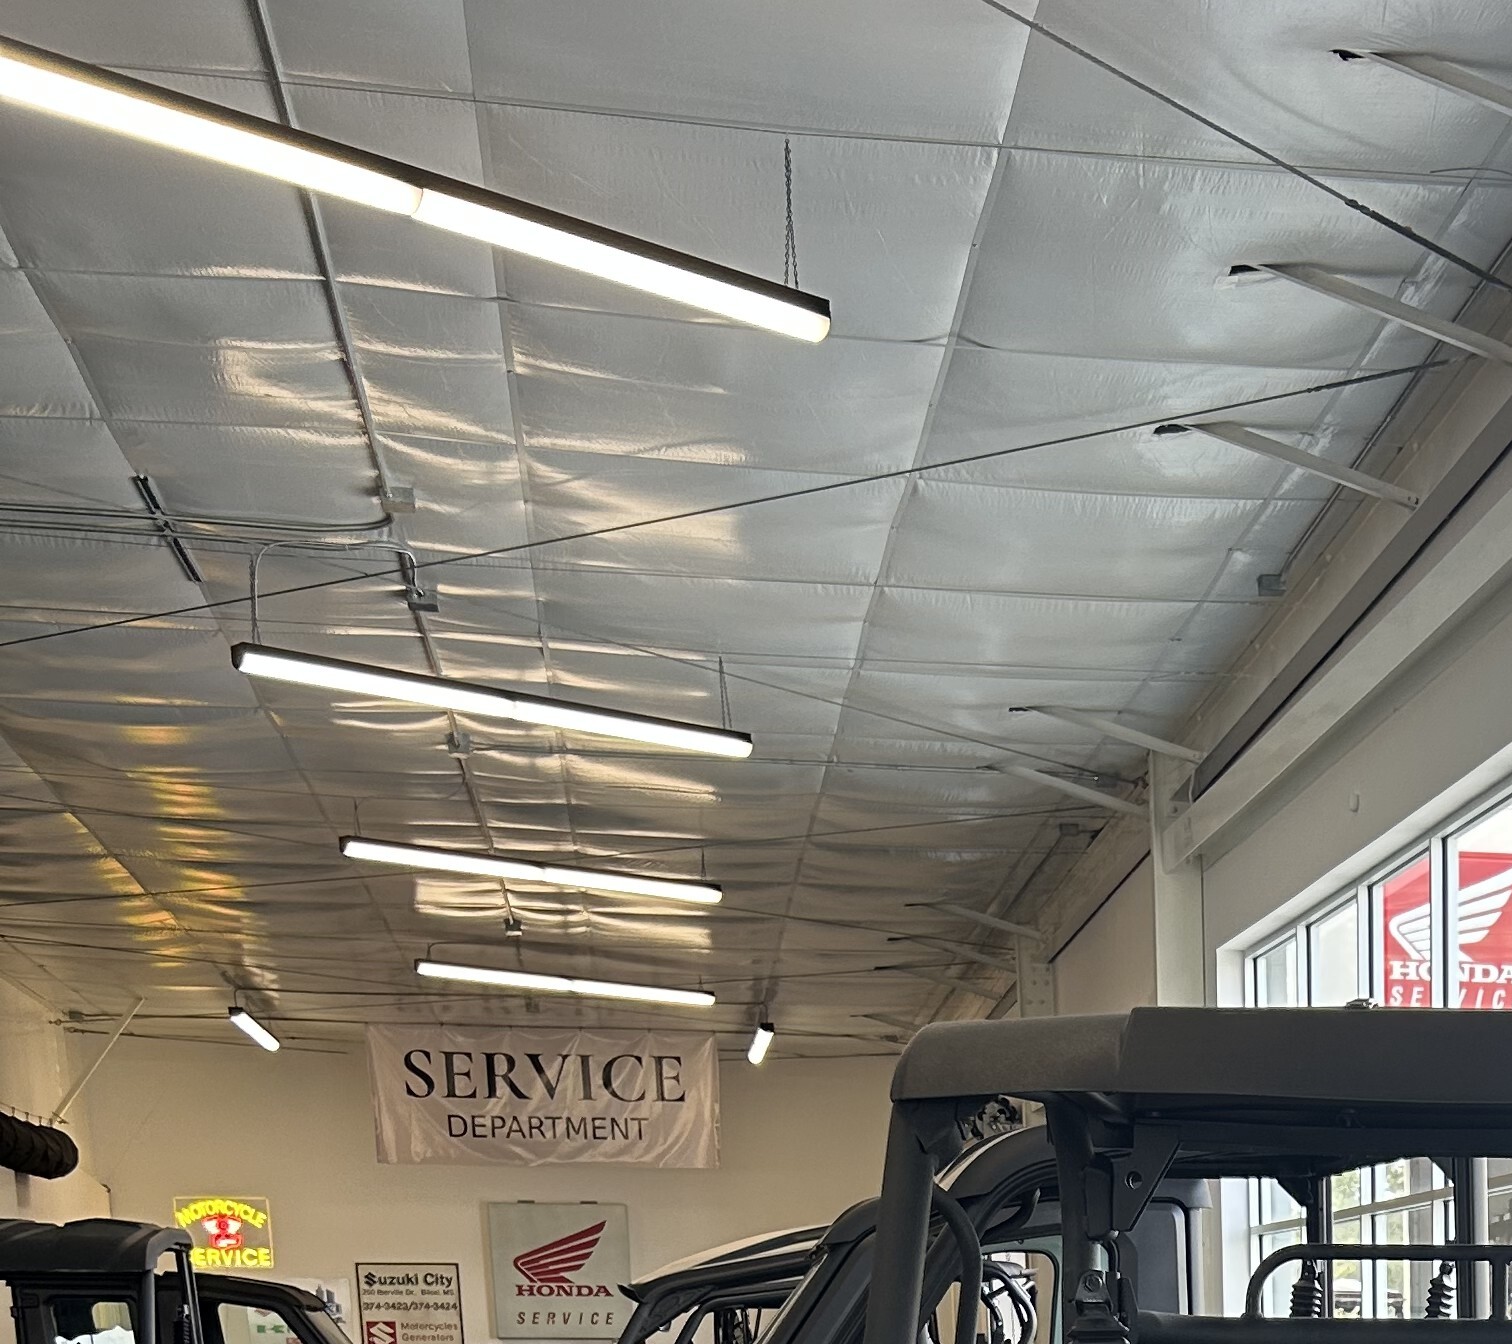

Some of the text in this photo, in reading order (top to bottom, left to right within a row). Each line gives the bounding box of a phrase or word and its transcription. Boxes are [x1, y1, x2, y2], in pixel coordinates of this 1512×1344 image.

[404, 1049, 686, 1103] SERVICE
[448, 1114, 649, 1141] DEPARTMENT
[175, 1199, 267, 1228] MOTORCYCLE
[364, 1272, 452, 1288] Suzuki City
[516, 1285, 614, 1297] HONDA
[517, 1312, 614, 1325] SERVICE
[401, 1322, 458, 1332] Motorcycles
[402, 1333, 454, 1341] Generators
